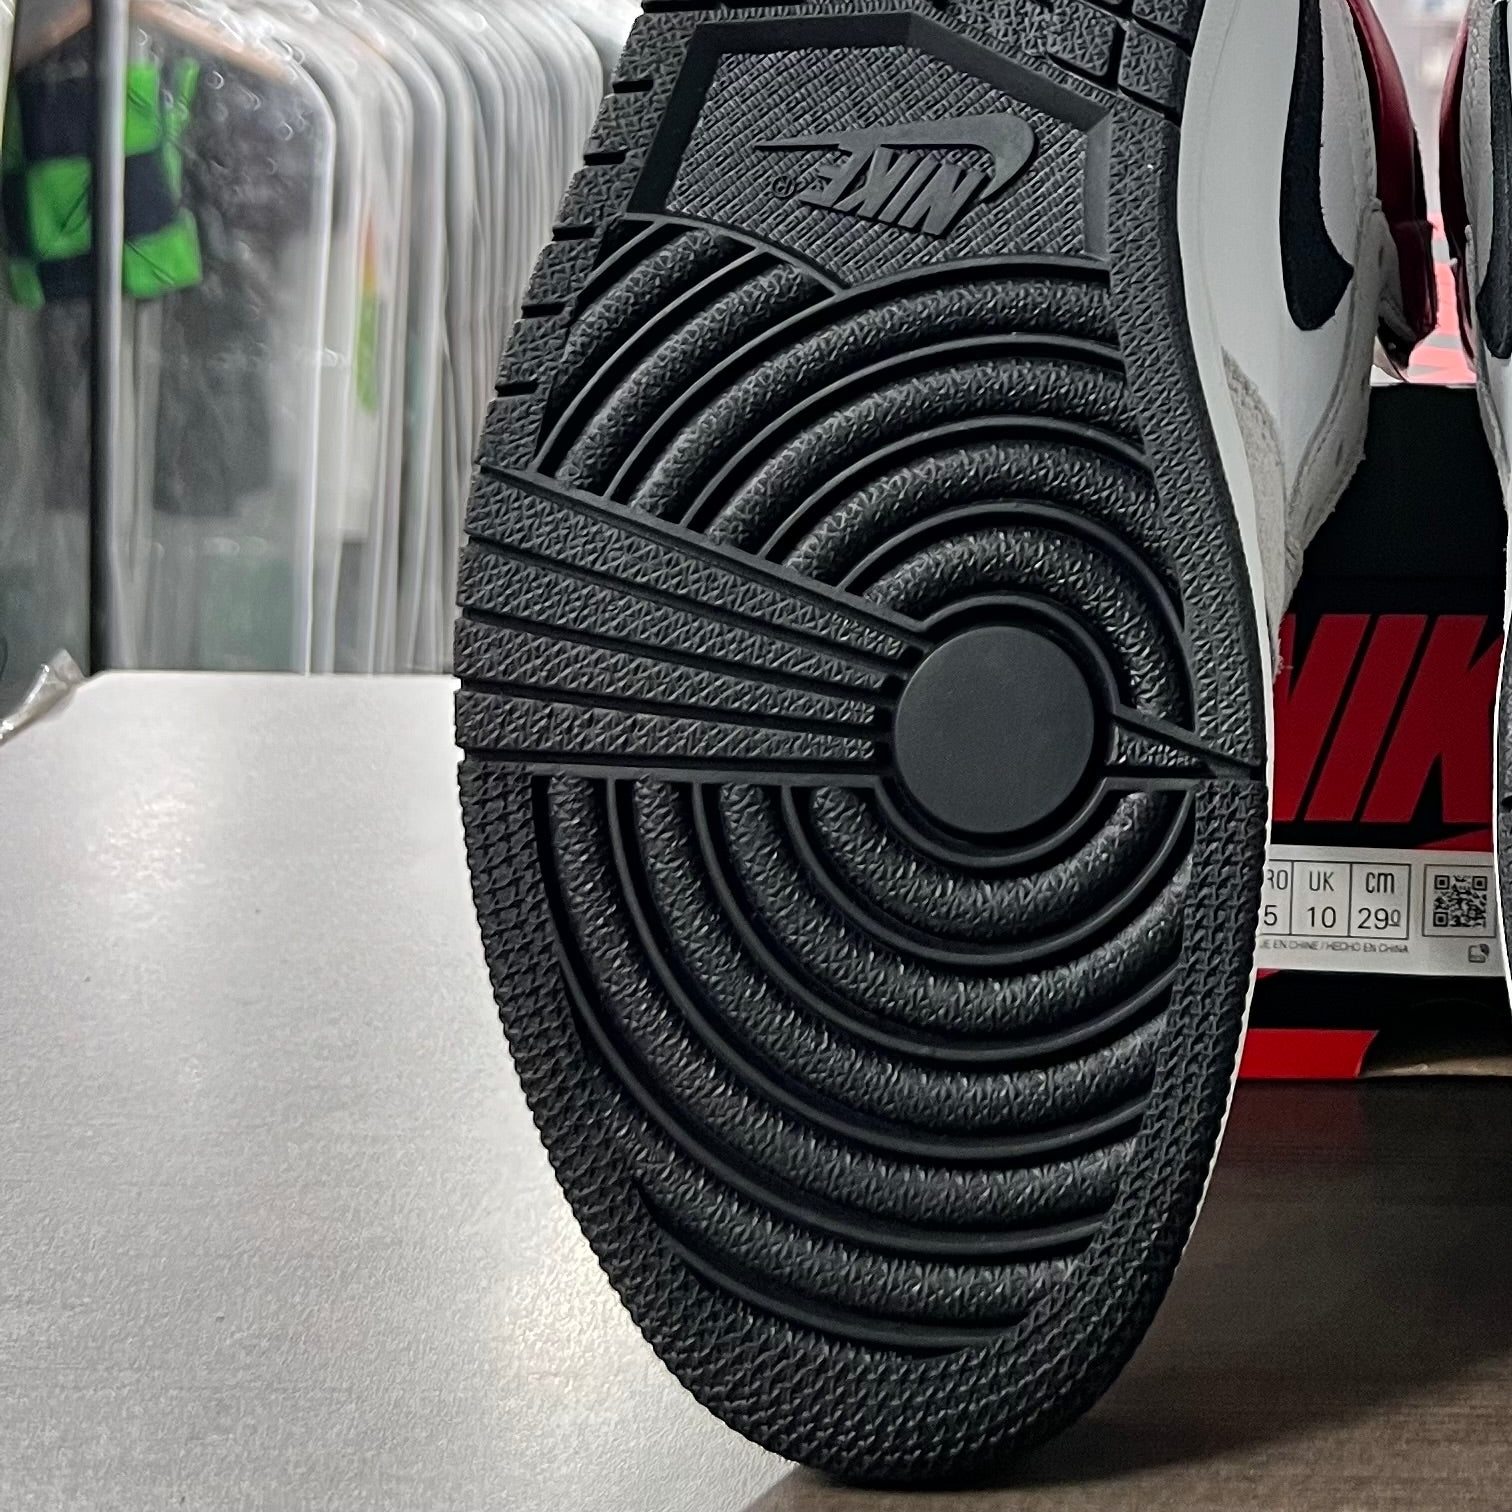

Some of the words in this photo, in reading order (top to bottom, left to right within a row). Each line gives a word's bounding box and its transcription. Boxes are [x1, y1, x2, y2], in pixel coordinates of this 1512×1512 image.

[801, 146, 991, 236] NIKE
[1272, 614, 1504, 823] NIK
[1267, 869, 1289, 890] RO
[1309, 871, 1335, 892] UK
[1263, 904, 1278, 926] 5
[1307, 906, 1337, 928] 10
